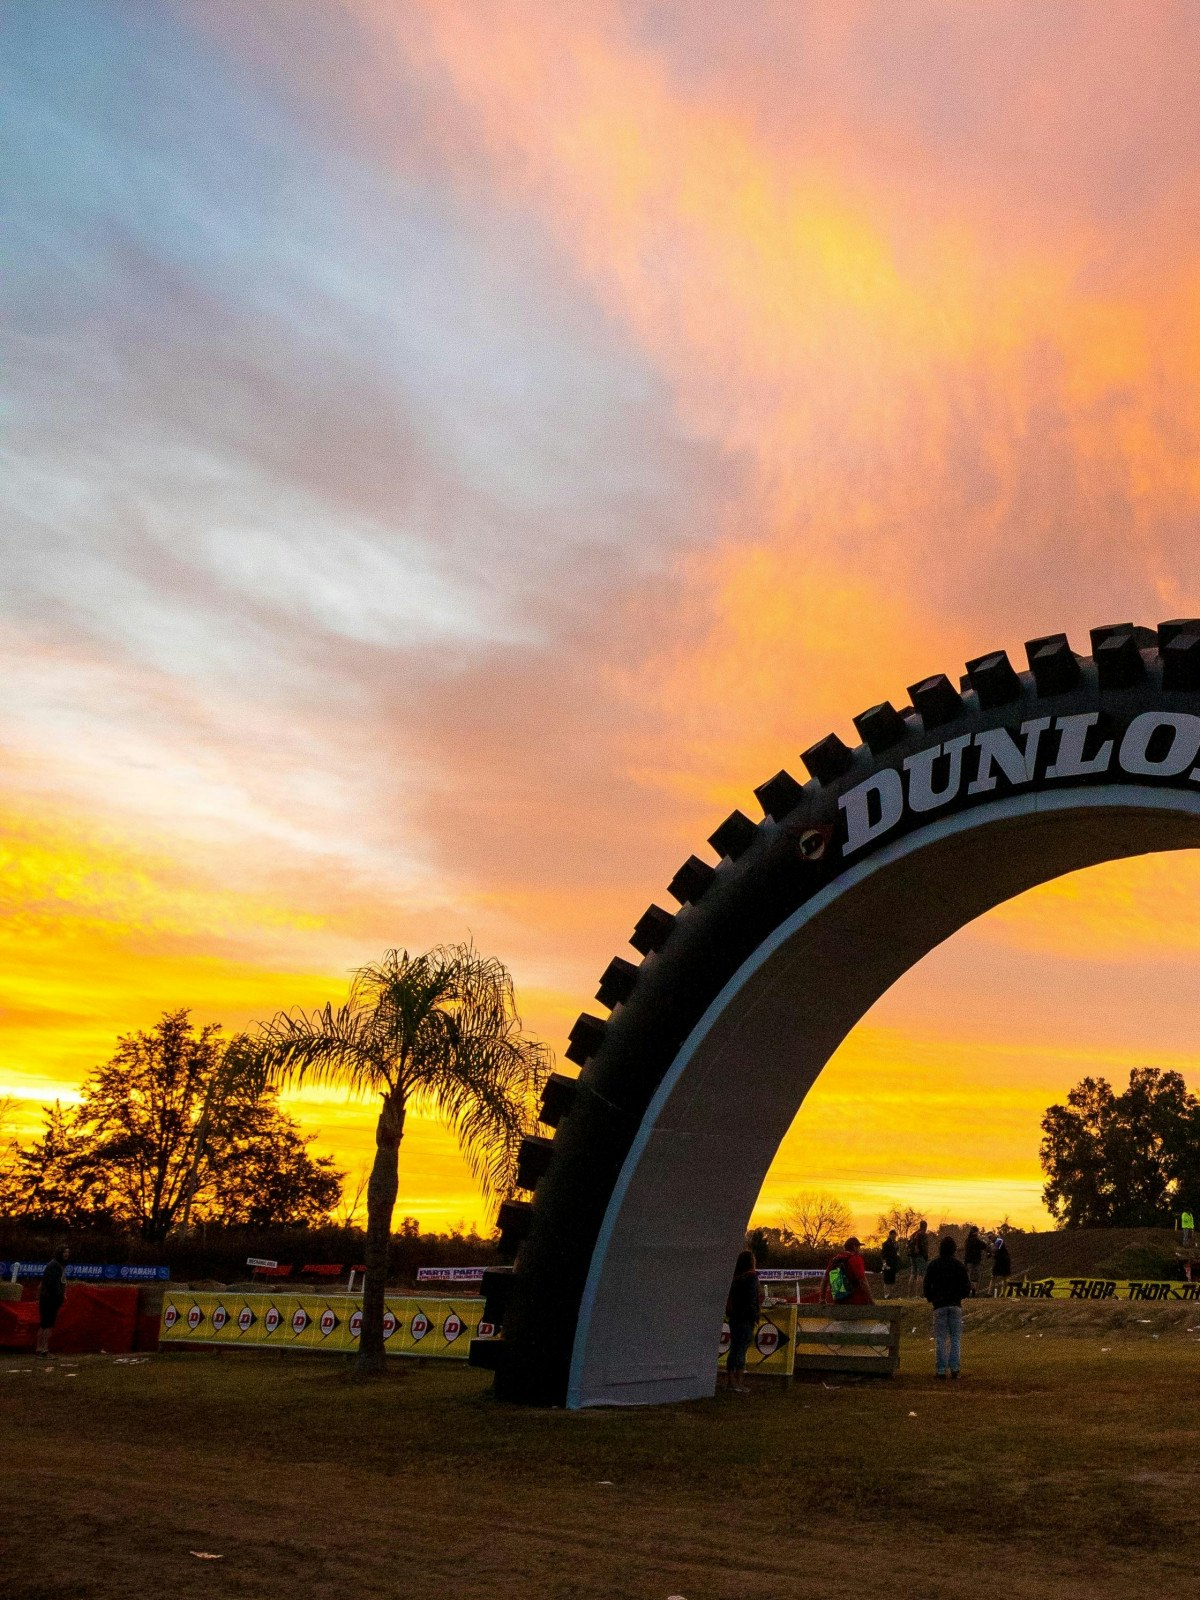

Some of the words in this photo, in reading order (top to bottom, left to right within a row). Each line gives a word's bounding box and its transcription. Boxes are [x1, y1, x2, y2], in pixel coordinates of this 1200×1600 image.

[73, 1265, 102, 1275] YAMAHA
[129, 1266, 157, 1275] YAMAHA
[1007, 1280, 1054, 1298] THOR
[1070, 1280, 1117, 1299] THOR
[1128, 1283, 1170, 1300] THOR
[166, 1312, 175, 1320] D
[190, 1312, 198, 1321] D
[215, 1313, 224, 1322] D
[240, 1314, 249, 1323] D
[267, 1315, 277, 1324] D
[294, 1316, 304, 1326] D
[323, 1317, 333, 1327] D
[413, 1321, 425, 1331] D
[444, 1323, 457, 1333] D
[479, 1324, 492, 1334] D
[760, 1333, 777, 1345] D
